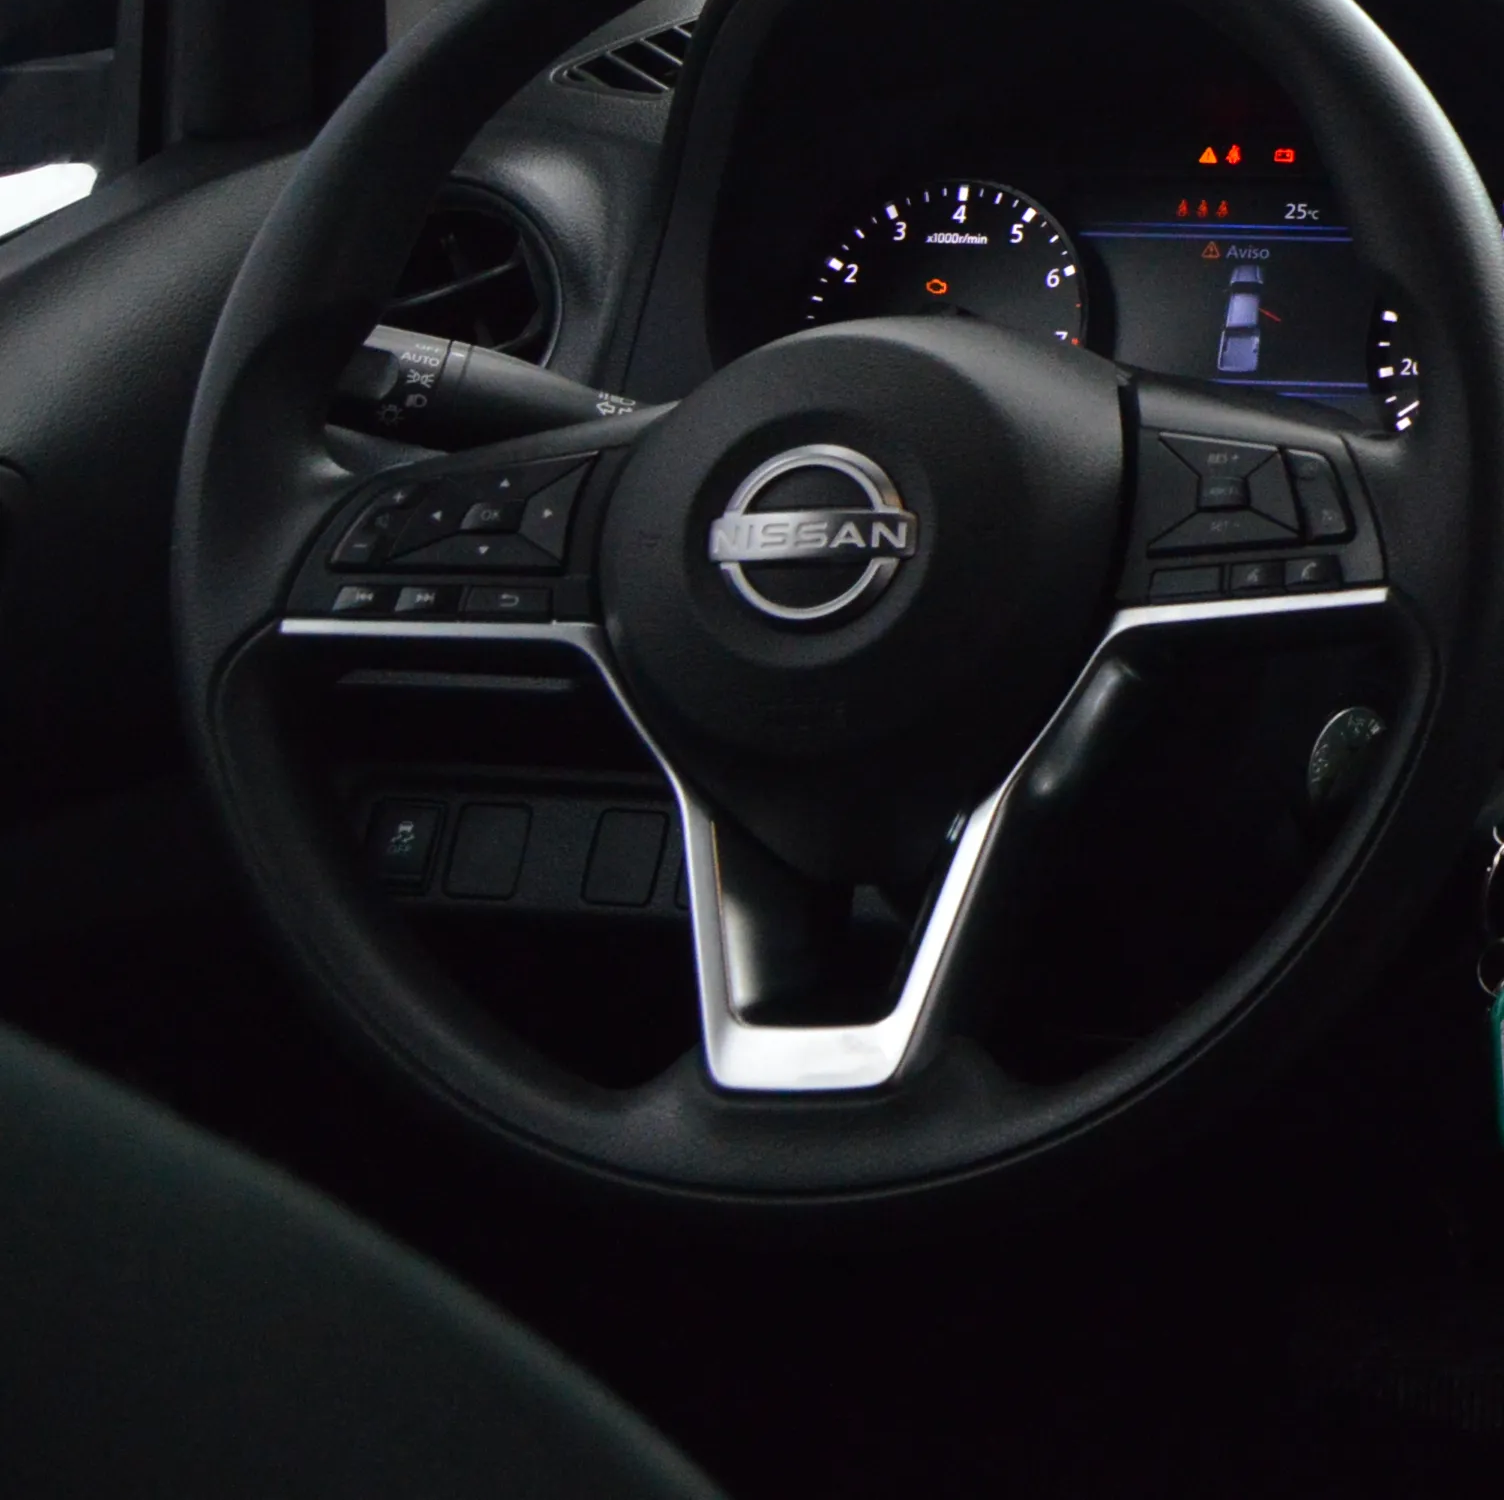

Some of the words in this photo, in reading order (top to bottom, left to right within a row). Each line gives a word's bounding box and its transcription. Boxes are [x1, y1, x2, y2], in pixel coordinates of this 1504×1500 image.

[952, 204, 967, 224] 4
[893, 221, 907, 241] 3
[925, 233, 988, 245] x1000r/min
[1010, 224, 1024, 243] 5
[1226, 245, 1270, 260] Aviso
[844, 264, 858, 283] 2
[1045, 268, 1060, 288] 6
[400, 351, 440, 367] AUTO
[713, 520, 908, 554] NISSAN
